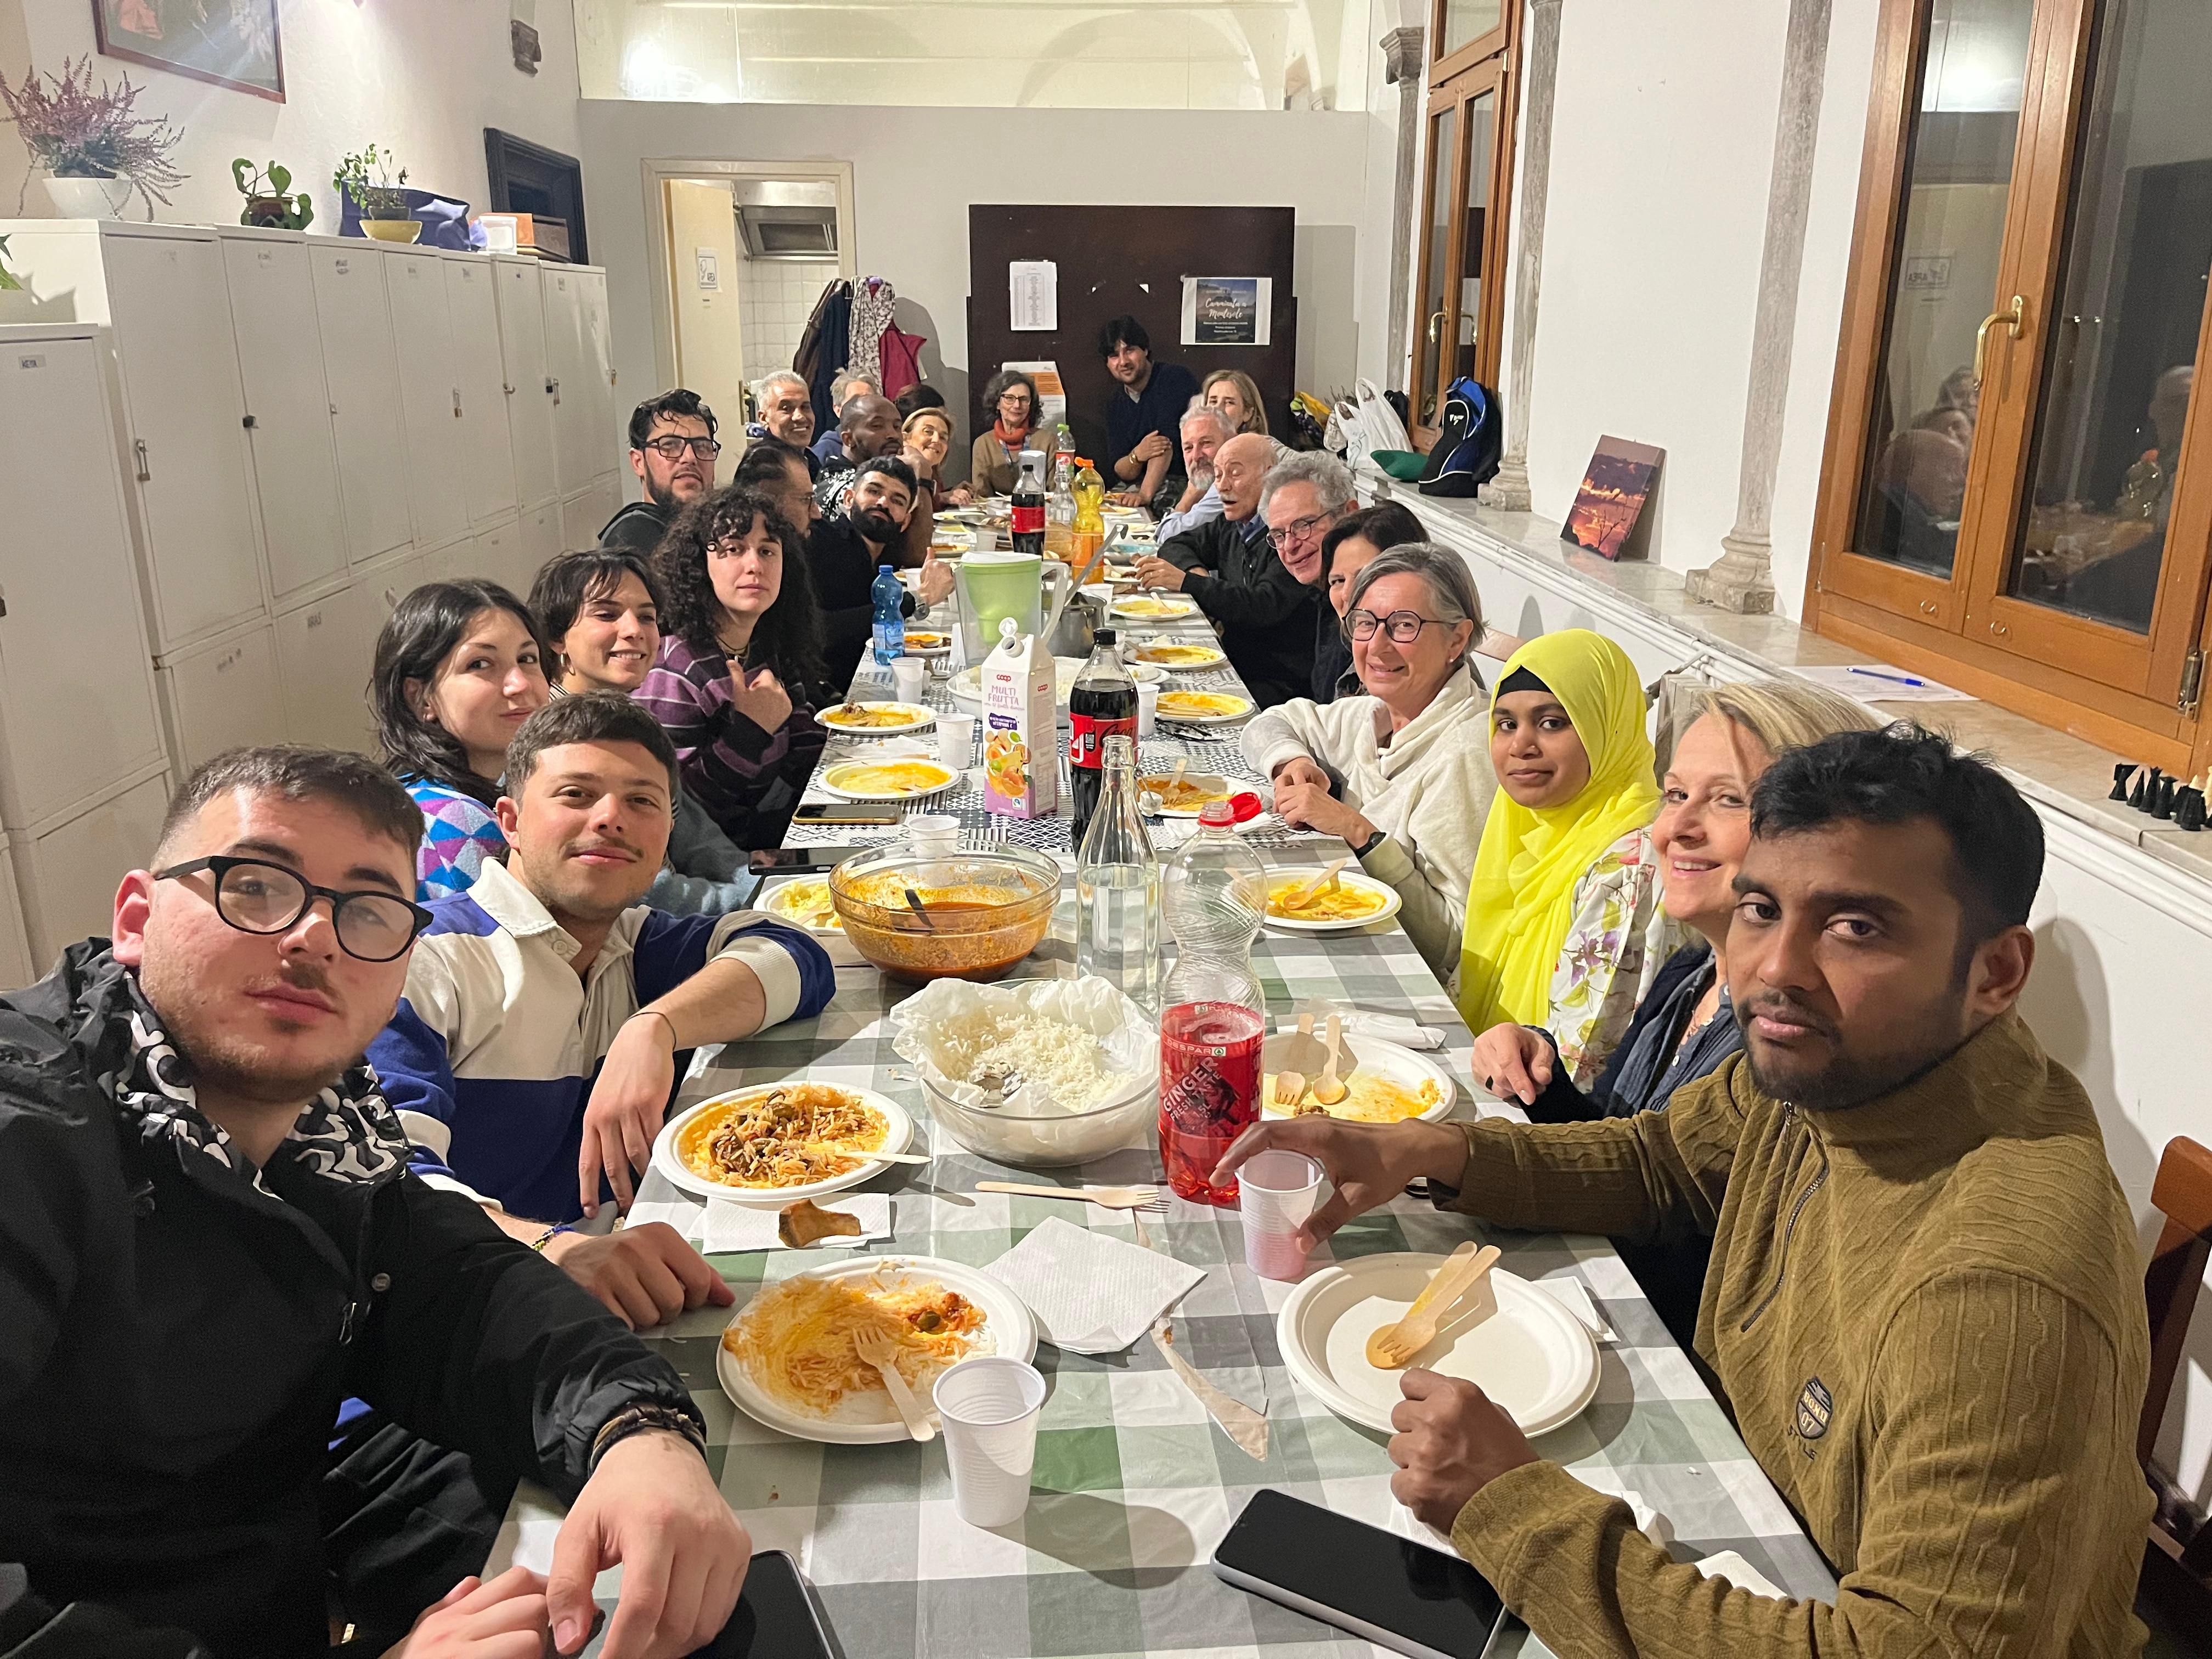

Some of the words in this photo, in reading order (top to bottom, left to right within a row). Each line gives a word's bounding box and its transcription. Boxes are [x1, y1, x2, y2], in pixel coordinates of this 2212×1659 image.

[988, 693, 1019, 706] FRUTTA
[991, 685, 1016, 696] MULTI
[1163, 1057, 1219, 1112] GINGER
[1170, 1098, 1194, 1122] FRESH
[1192, 1070, 1222, 1098] TASTE
[1804, 1391, 1827, 1423] BOND
[1801, 1412, 1815, 1432] 07
